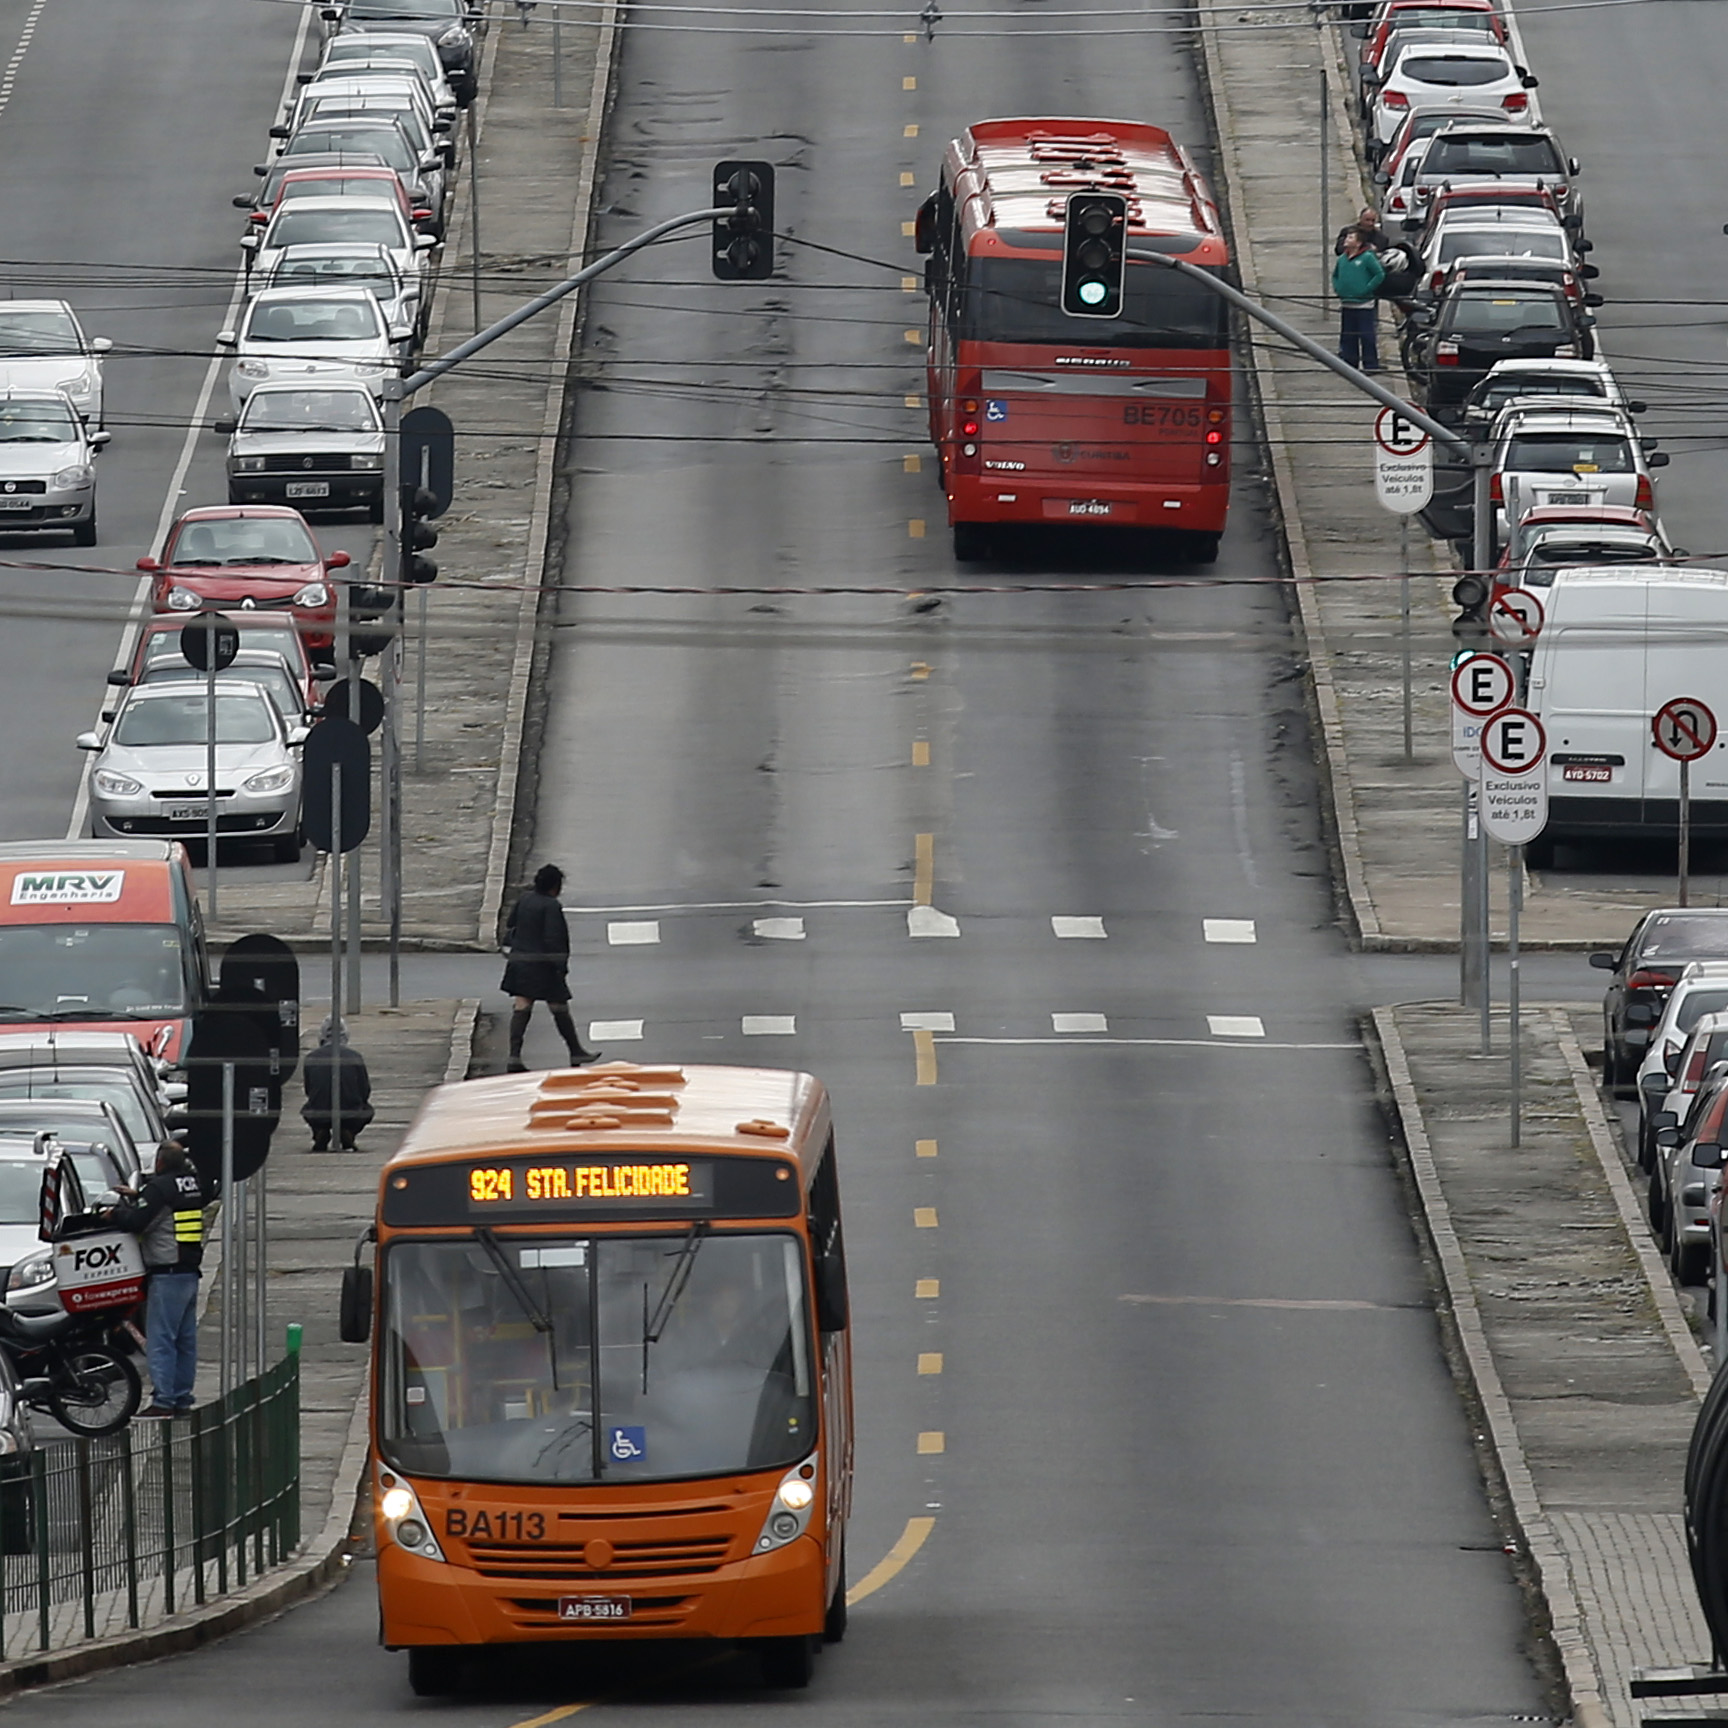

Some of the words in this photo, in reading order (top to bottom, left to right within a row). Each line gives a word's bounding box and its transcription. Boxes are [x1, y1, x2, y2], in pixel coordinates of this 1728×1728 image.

[1123, 405, 1201, 427] BE705
[1392, 413, 1413, 445] E
[1080, 450, 1131, 460] CURITIBA
[1379, 462, 1427, 472] Exclusivo
[1381, 474, 1424, 483] Veículos
[1472, 668, 1494, 703] E
[1501, 722, 1525, 760] E
[1485, 780, 1541, 791] Exclusivo
[1488, 794, 1538, 805] Veículos
[1491, 808, 1510, 820] até
[22, 875, 116, 891] MRV
[19, 891, 114, 901] Engenharia
[175, 1175, 199, 1193] FOX
[470, 1168, 512, 1201] 924
[74, 1242, 122, 1272] FOX
[83, 1265, 129, 1280] EXPRESS
[446, 1507, 546, 1540] BA113
[565, 1604, 624, 1617] APB-5816
